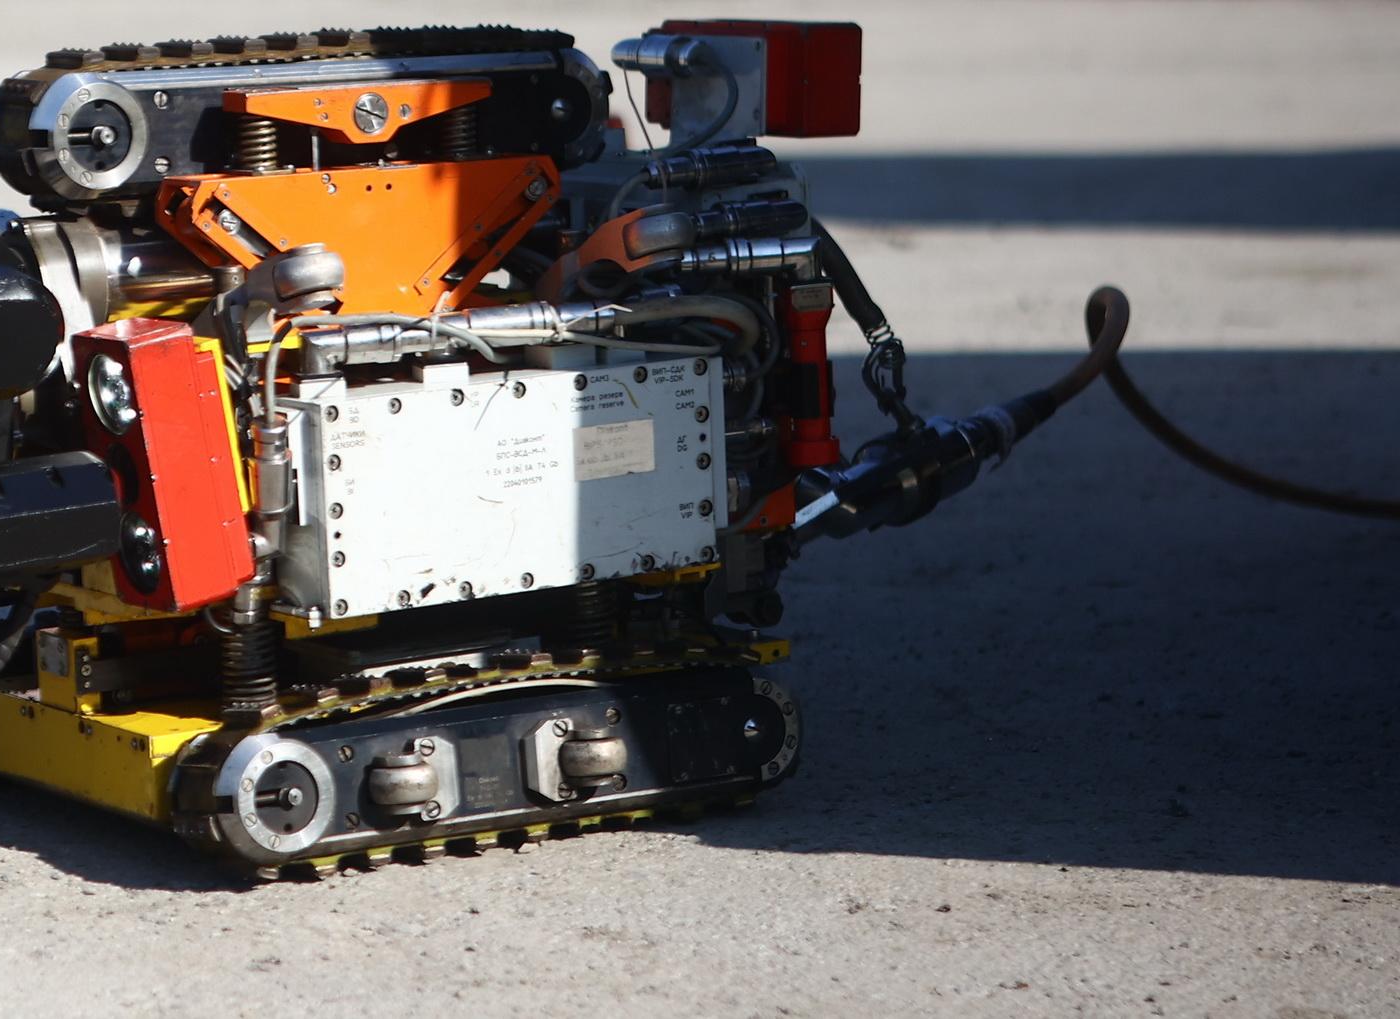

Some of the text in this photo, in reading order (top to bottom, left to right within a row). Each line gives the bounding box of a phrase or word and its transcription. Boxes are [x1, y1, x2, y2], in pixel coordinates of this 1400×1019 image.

[654, 374, 684, 384] VIP-SDK
[675, 389, 695, 398] CAM1
[599, 400, 624, 409] reserve
[675, 401, 695, 410] CAM2
[332, 440, 365, 450] SENSORS
[679, 502, 694, 511] ВИП
[681, 511, 693, 519] VIP
